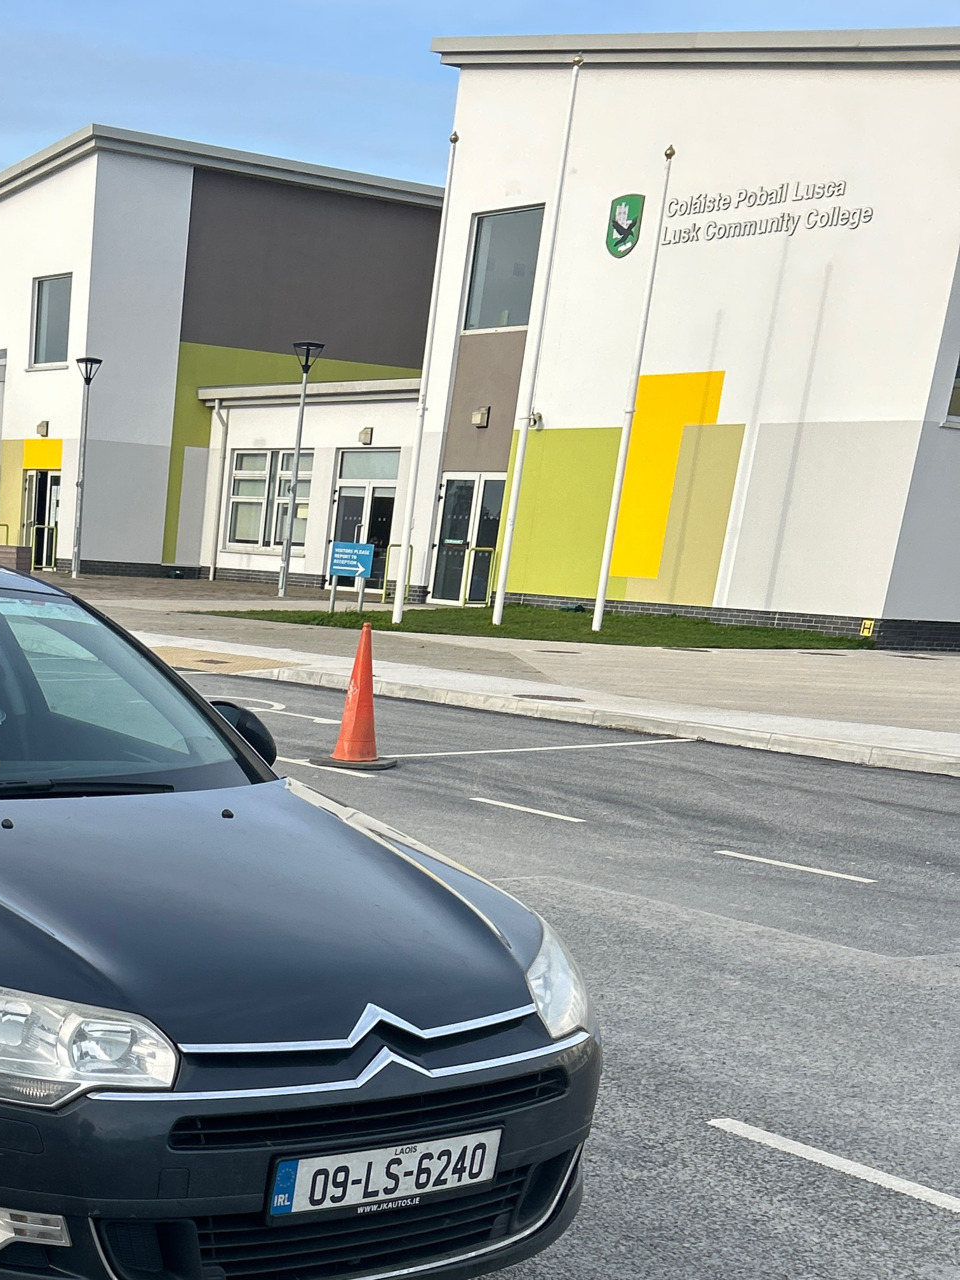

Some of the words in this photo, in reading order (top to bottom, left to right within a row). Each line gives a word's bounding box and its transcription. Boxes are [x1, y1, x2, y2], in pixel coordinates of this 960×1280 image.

[667, 194, 732, 217] Coláiste
[735, 182, 789, 209] Pobail
[792, 179, 847, 201] Lusca
[660, 226, 701, 246] Lusk
[704, 212, 801, 242] Community
[805, 205, 873, 230] College
[394, 1145, 418, 1156] LAOIS
[308, 1142, 487, 1207] 09-LS-6240
[273, 1194, 291, 1206] IRL
[357, 1197, 420, 1214] WWW.JKAUTOS.IE
